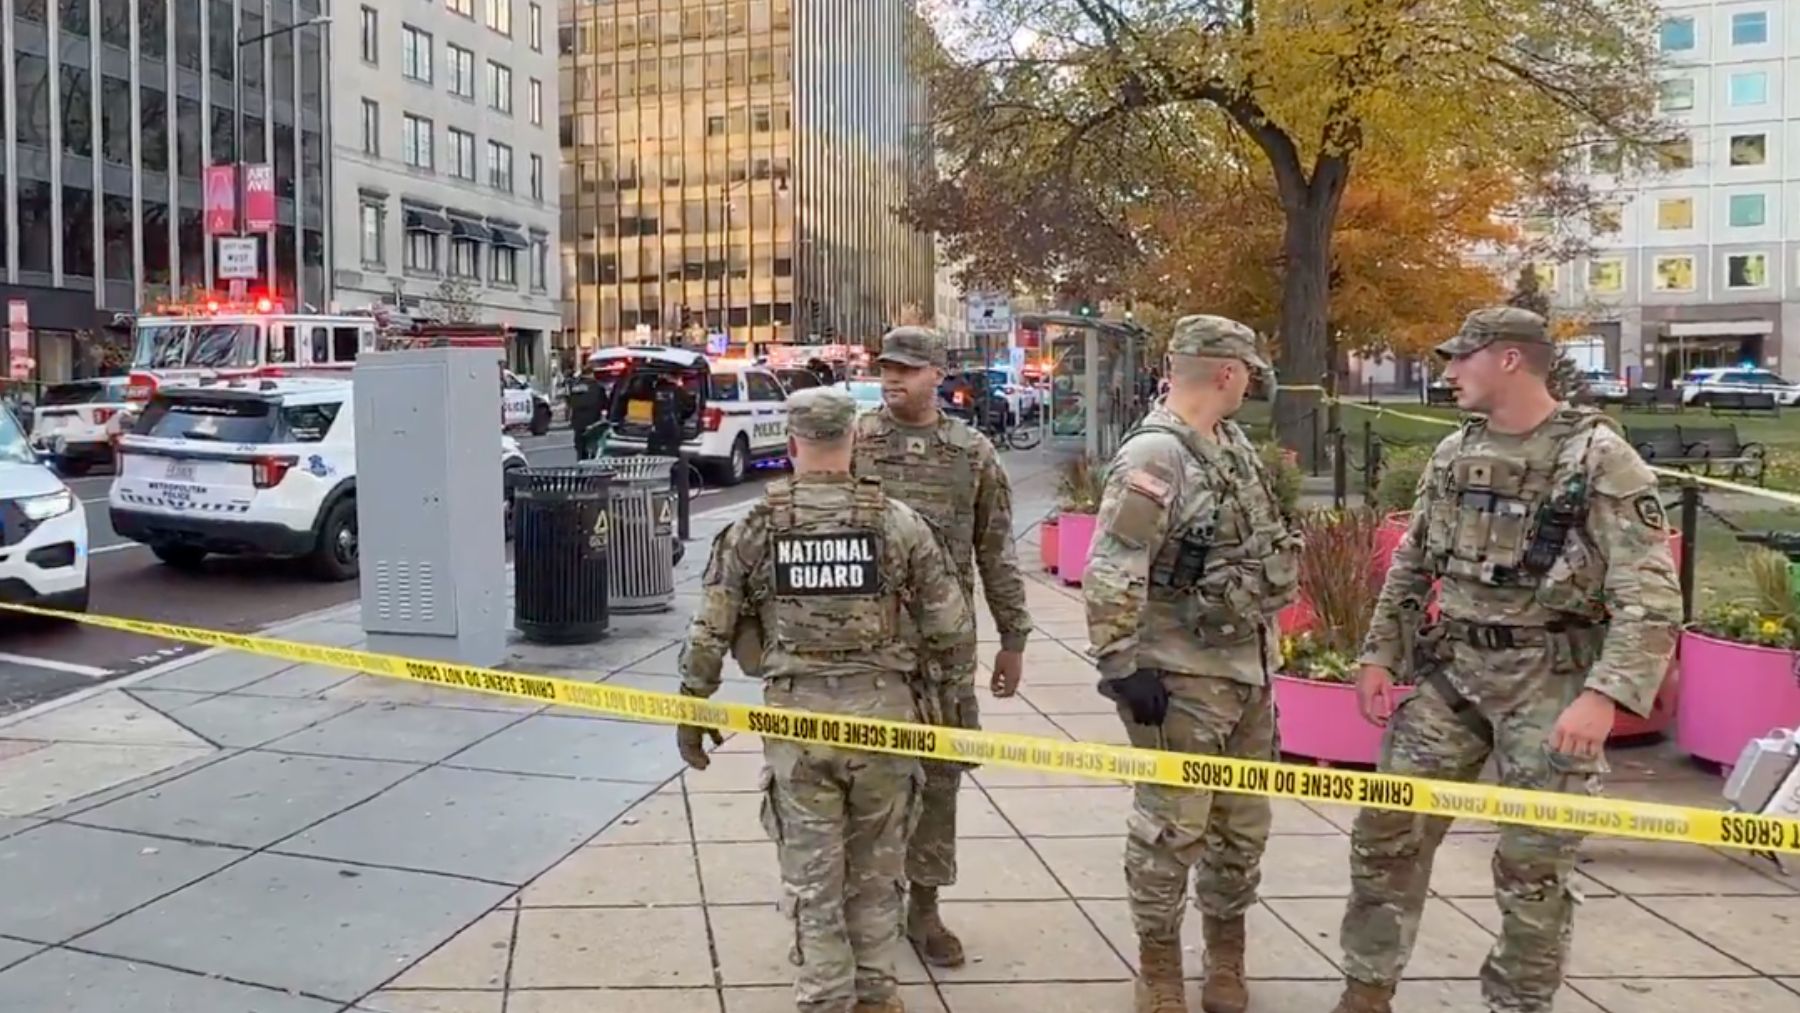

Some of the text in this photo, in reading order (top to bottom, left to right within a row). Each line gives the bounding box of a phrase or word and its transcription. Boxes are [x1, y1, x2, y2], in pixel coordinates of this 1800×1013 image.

[247, 167, 271, 180] ART
[246, 180, 271, 192] AVE
[753, 421, 781, 438] POLICE
[163, 490, 191, 501] POLICE
[778, 538, 873, 563] NATIONAL
[789, 564, 864, 588] GUARD
[442, 667, 464, 685] NOT
[464, 670, 482, 687] DO
[481, 671, 518, 693] SCENE
[519, 678, 556, 699] CRIME
[604, 691, 626, 709] NOT
[628, 695, 646, 713] DO
[648, 696, 688, 719] SCENE
[748, 711, 936, 752] CRIME SCENE DO NOT CROSS
[1000, 746, 1028, 762] NOT
[1032, 750, 1052, 766] DO
[1056, 753, 1104, 772] SCENE
[1108, 758, 1157, 777] CRIME
[1182, 760, 1413, 806] CRIME SCENE DO NOT CROSS
[1430, 790, 1689, 835] CRIME SCENE DO NOT CROSS
[1721, 816, 1784, 848] CROSS
